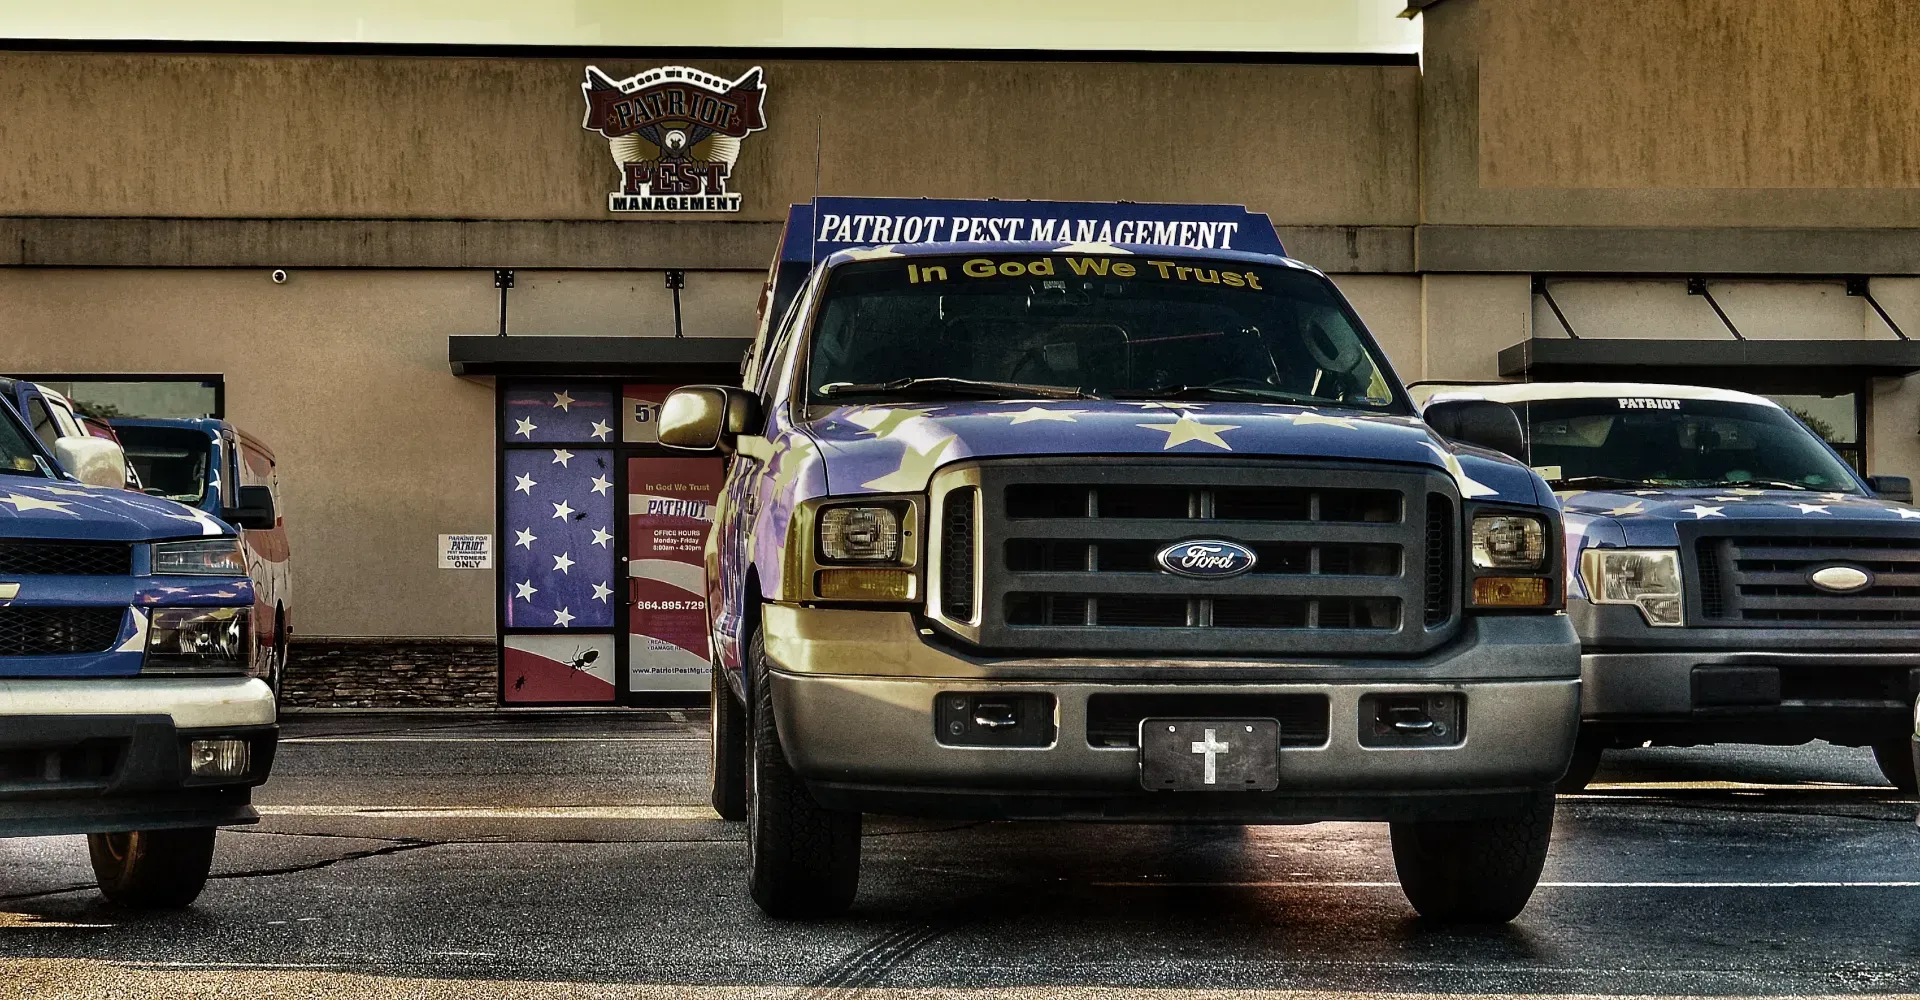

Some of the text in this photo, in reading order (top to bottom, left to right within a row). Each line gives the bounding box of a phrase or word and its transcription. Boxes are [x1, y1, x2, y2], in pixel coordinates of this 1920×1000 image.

[687, 71, 729, 91] TRUST
[613, 88, 738, 129] PATRIOT
[623, 161, 728, 195] PEST
[612, 197, 740, 210] MANAGEMENT
[817, 214, 1238, 250] PATRIOT PEST MANAGEMENT
[907, 258, 1263, 290] In God We Trust
[1618, 398, 1680, 409] PATRIOT
[645, 483, 710, 491] In God We Trust
[648, 500, 709, 517] PATRIOT
[451, 541, 484, 550] PATRIOT
[680, 537, 699, 545] Friday
[1181, 545, 1235, 569] Ford
[637, 600, 706, 610] 864.895.729
